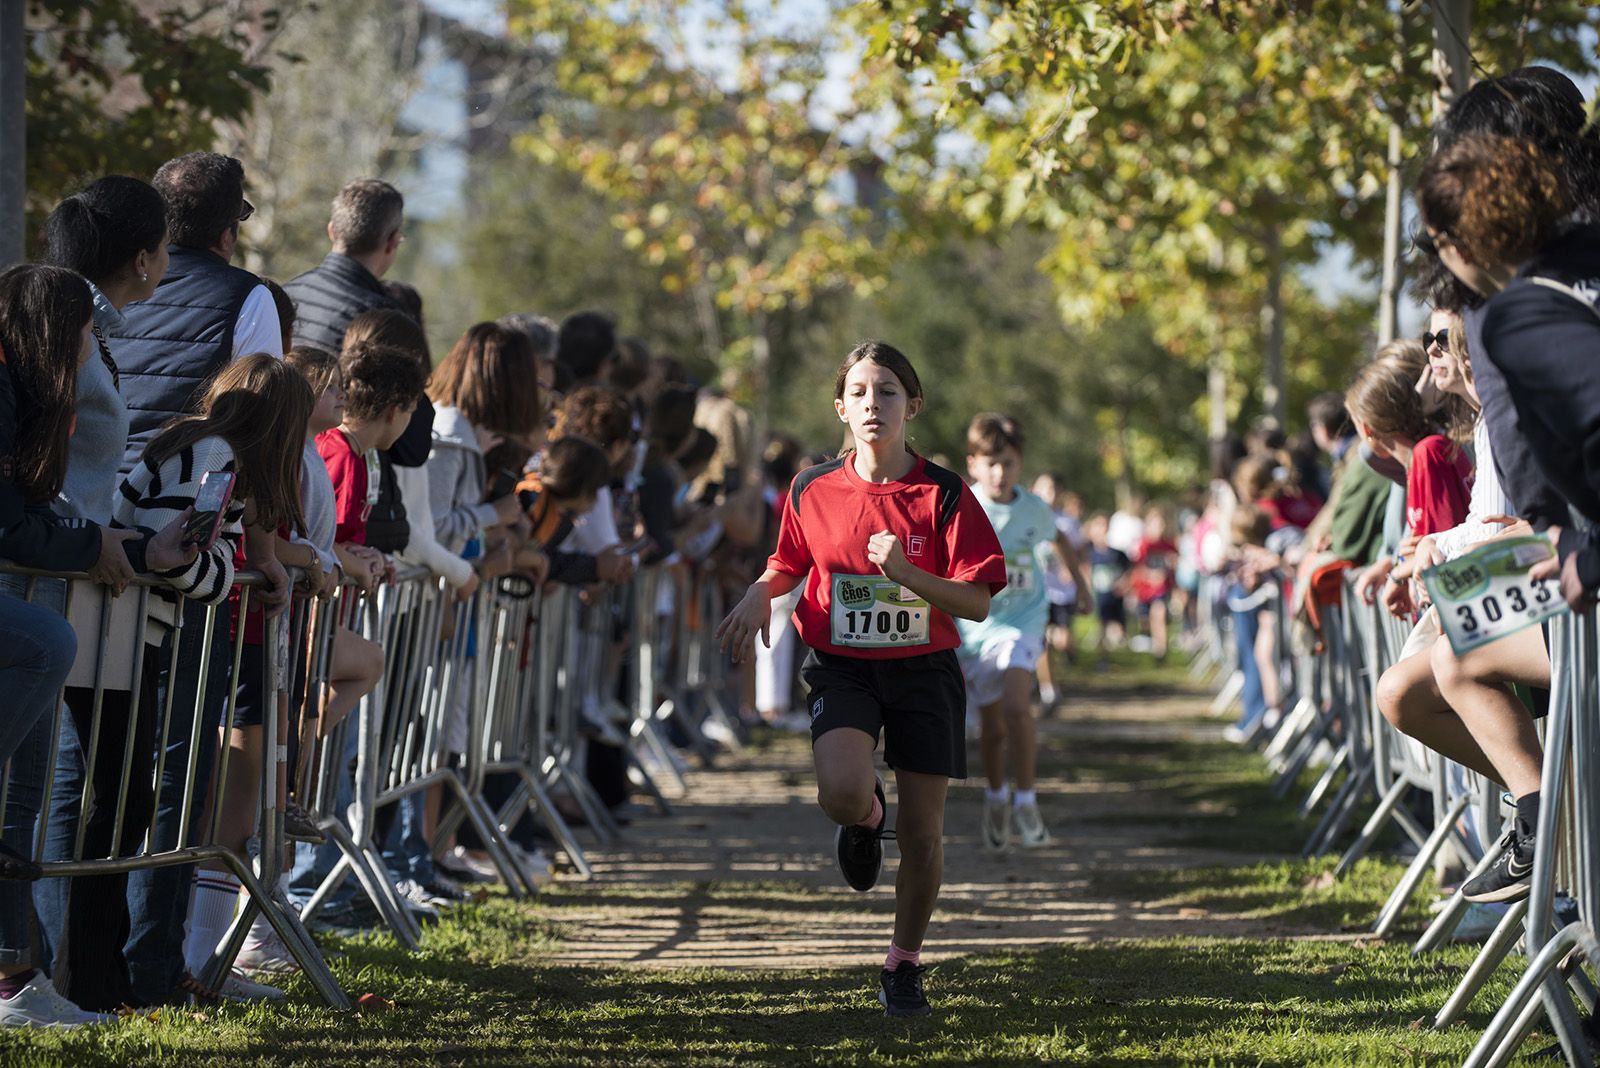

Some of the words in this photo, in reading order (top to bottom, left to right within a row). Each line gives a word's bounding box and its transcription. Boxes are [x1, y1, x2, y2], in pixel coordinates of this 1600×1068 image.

[842, 586, 870, 601] CROS
[1456, 579, 1551, 632] 3033
[845, 610, 910, 633] 1700
